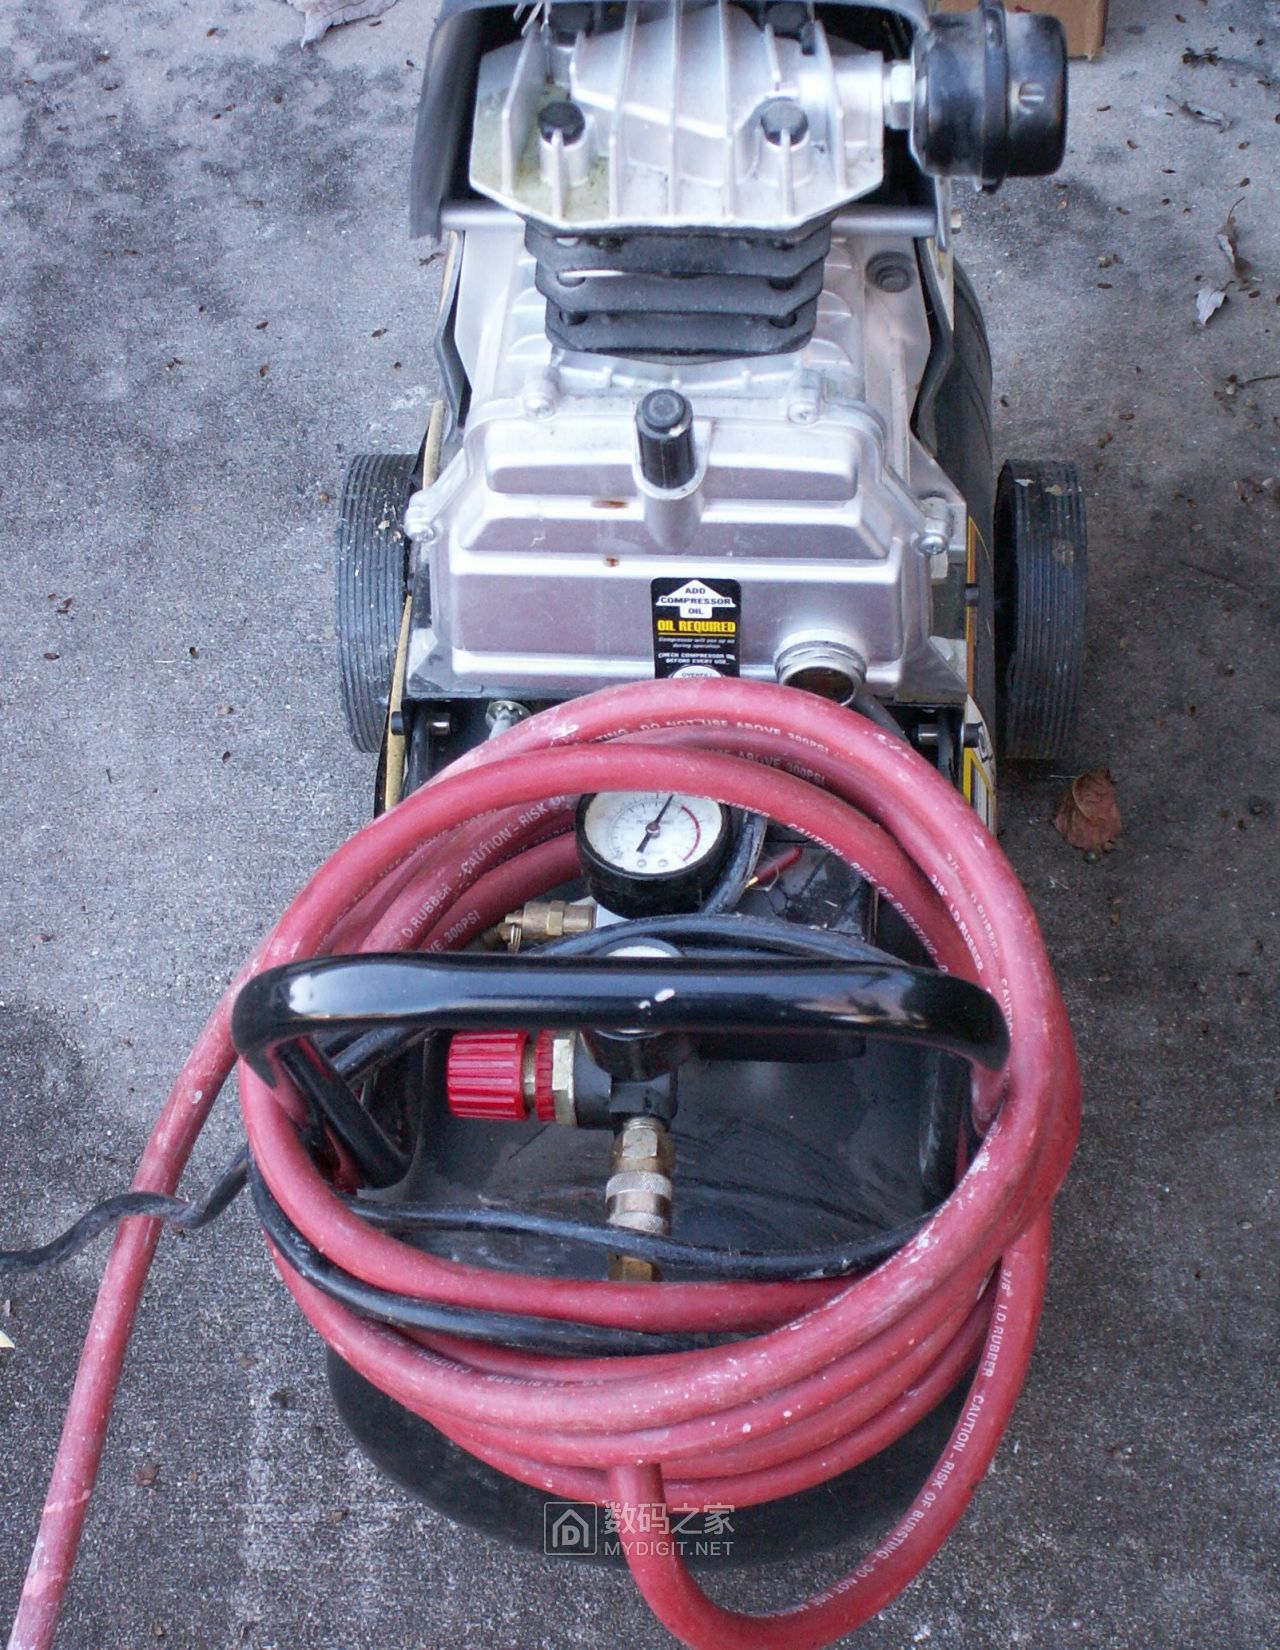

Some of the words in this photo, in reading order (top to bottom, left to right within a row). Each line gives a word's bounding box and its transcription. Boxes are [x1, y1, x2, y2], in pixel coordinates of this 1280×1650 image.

[660, 596, 731, 605] COMPRESSOR
[688, 607, 704, 615] OIL
[657, 620, 676, 631] OIL
[678, 620, 736, 633] REQUIRED
[519, 802, 549, 828] RISK
[443, 910, 481, 943] 300PSI
[953, 1394, 985, 1452] CAUTION
[931, 1460, 955, 1490] RISK
[921, 1491, 937, 1509] OF
[875, 1510, 925, 1560] BURSTING
[857, 1564, 875, 1579] DO
